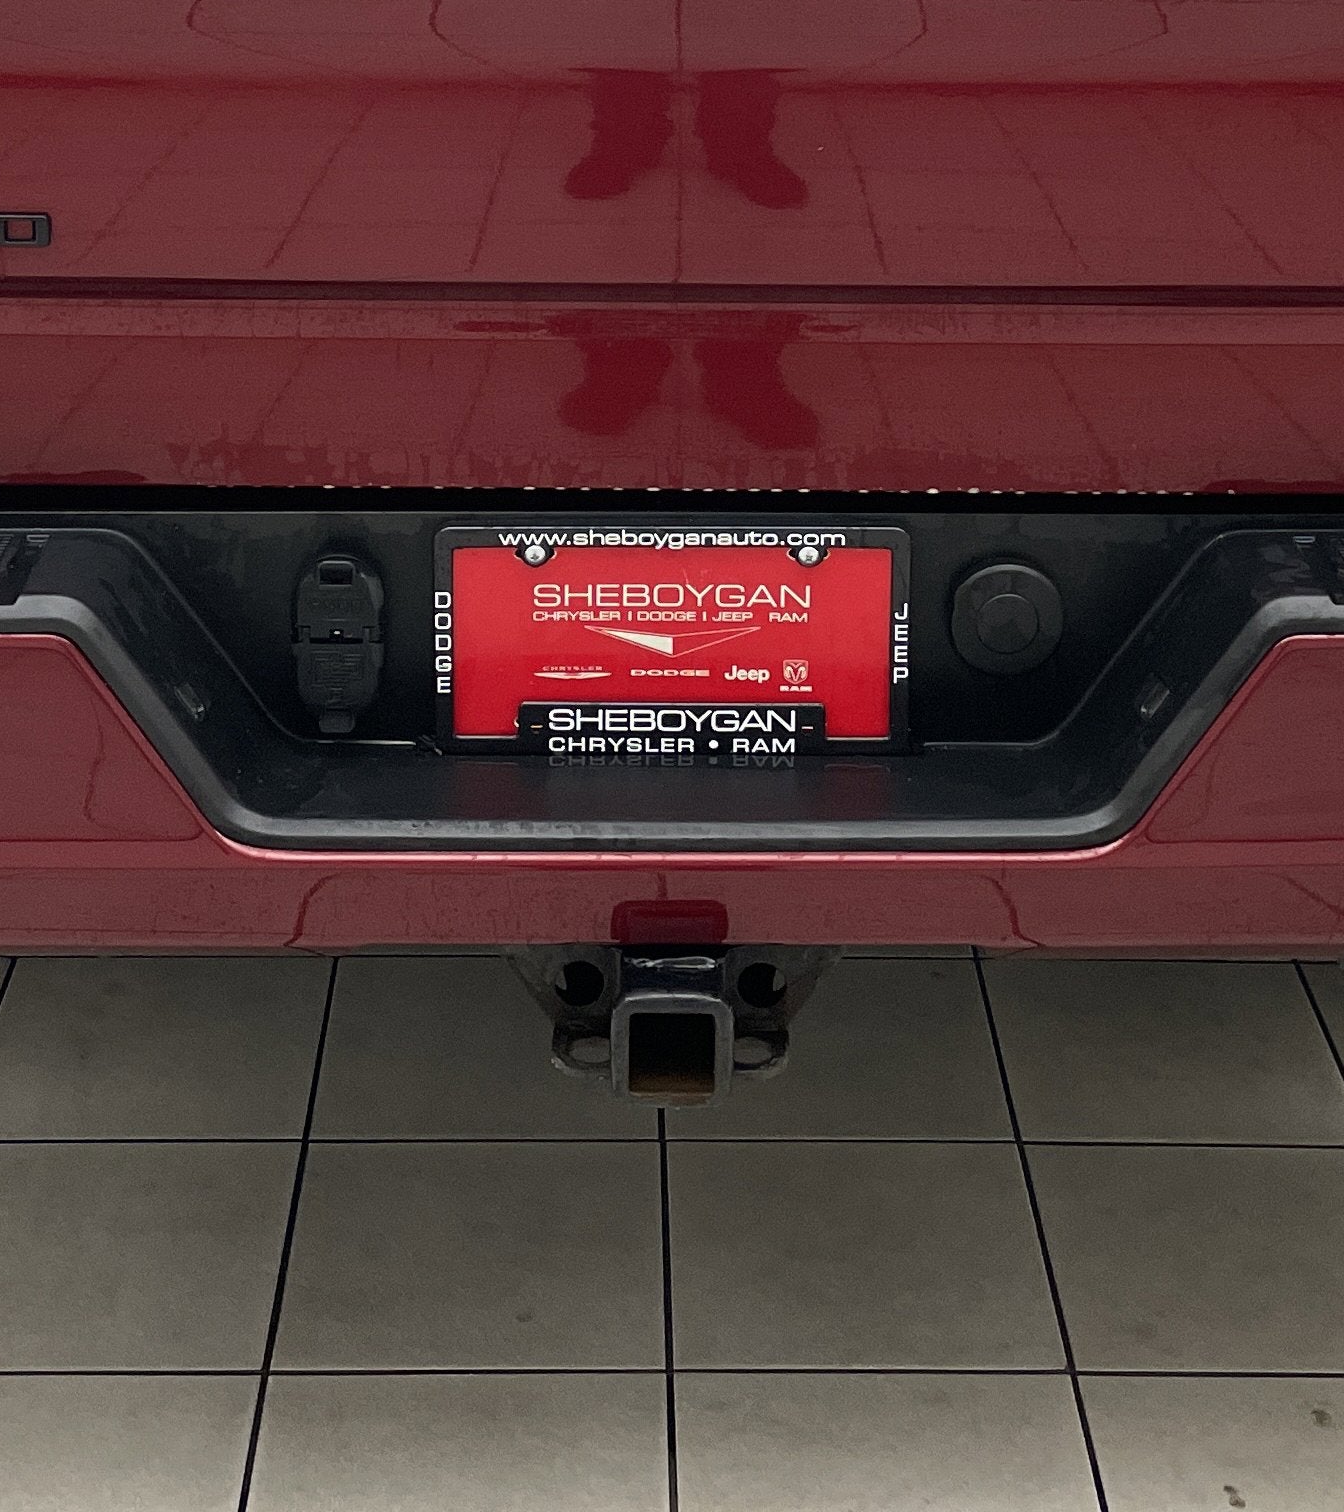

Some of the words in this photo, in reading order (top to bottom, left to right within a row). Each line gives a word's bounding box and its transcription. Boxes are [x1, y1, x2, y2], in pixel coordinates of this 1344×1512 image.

[498, 528, 846, 550] www.sheboyganauto.com
[533, 583, 811, 608] SHEBOYGAN
[532, 610, 621, 622] CHRYSLER
[636, 610, 697, 622] DODGE
[712, 611, 754, 623] JEEP
[768, 611, 808, 623] RAM
[434, 591, 452, 694] DODGE
[893, 602, 909, 684] JEEP
[630, 669, 710, 677] DODGE
[724, 665, 770, 683] Jeep
[548, 708, 796, 732] SHEBOYGAN
[548, 736, 695, 753] CHRYSLER
[732, 737, 796, 754] RAM
